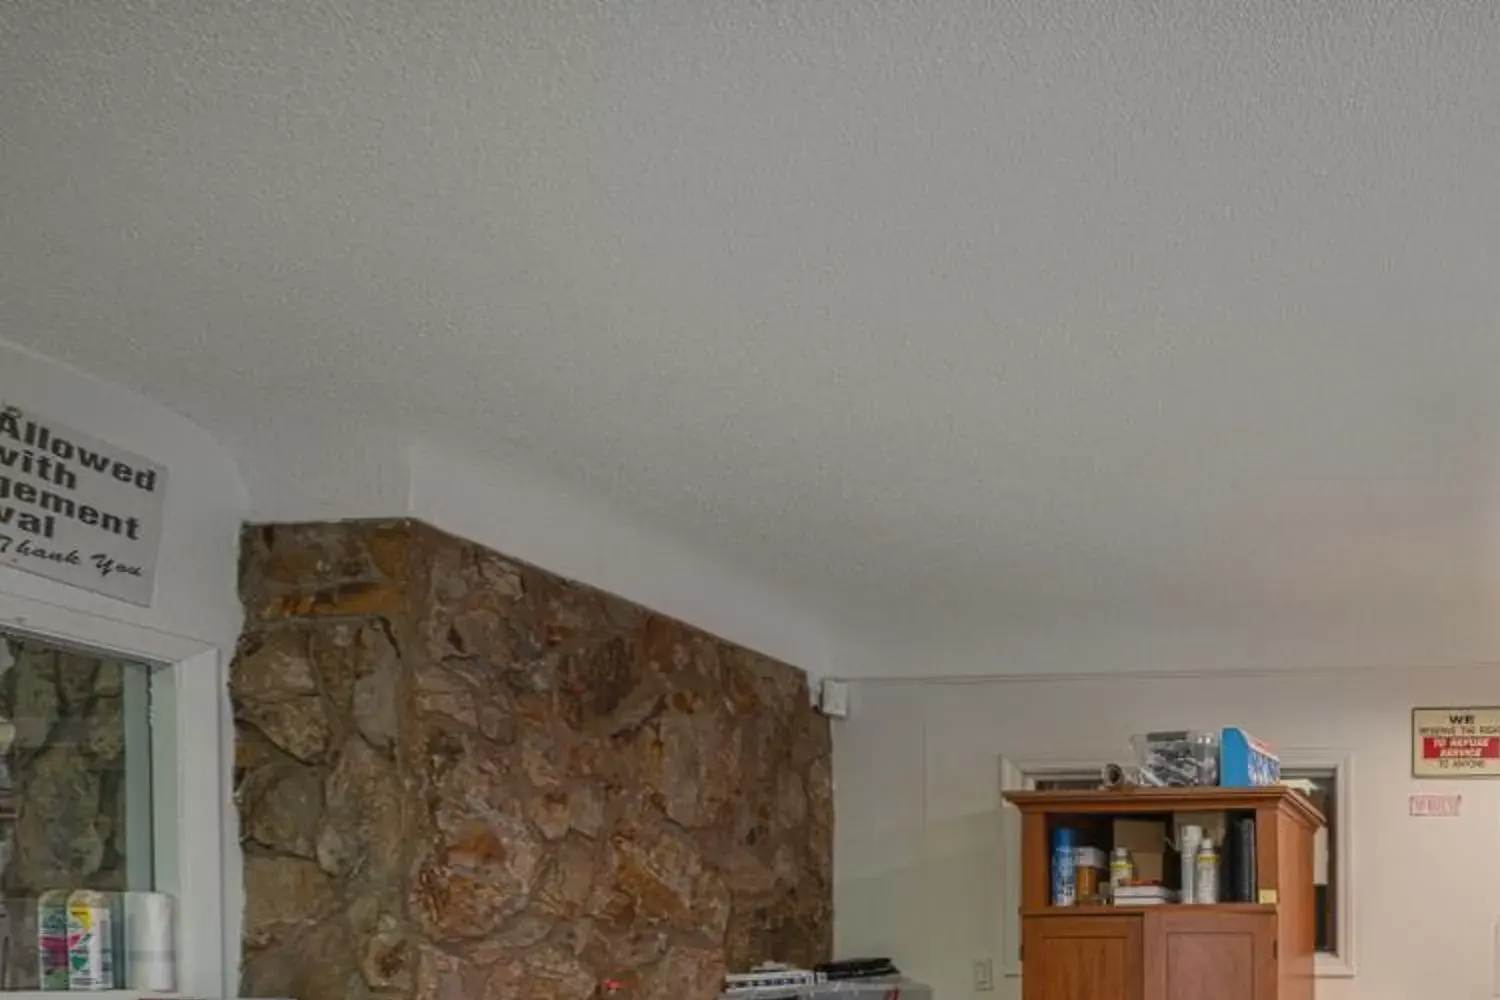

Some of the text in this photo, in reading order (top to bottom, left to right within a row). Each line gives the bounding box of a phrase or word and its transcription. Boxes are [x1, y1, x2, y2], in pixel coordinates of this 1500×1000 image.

[0, 411, 156, 491] Allowed
[90, 553, 142, 577] You
[1450, 714, 1475, 724] WE
